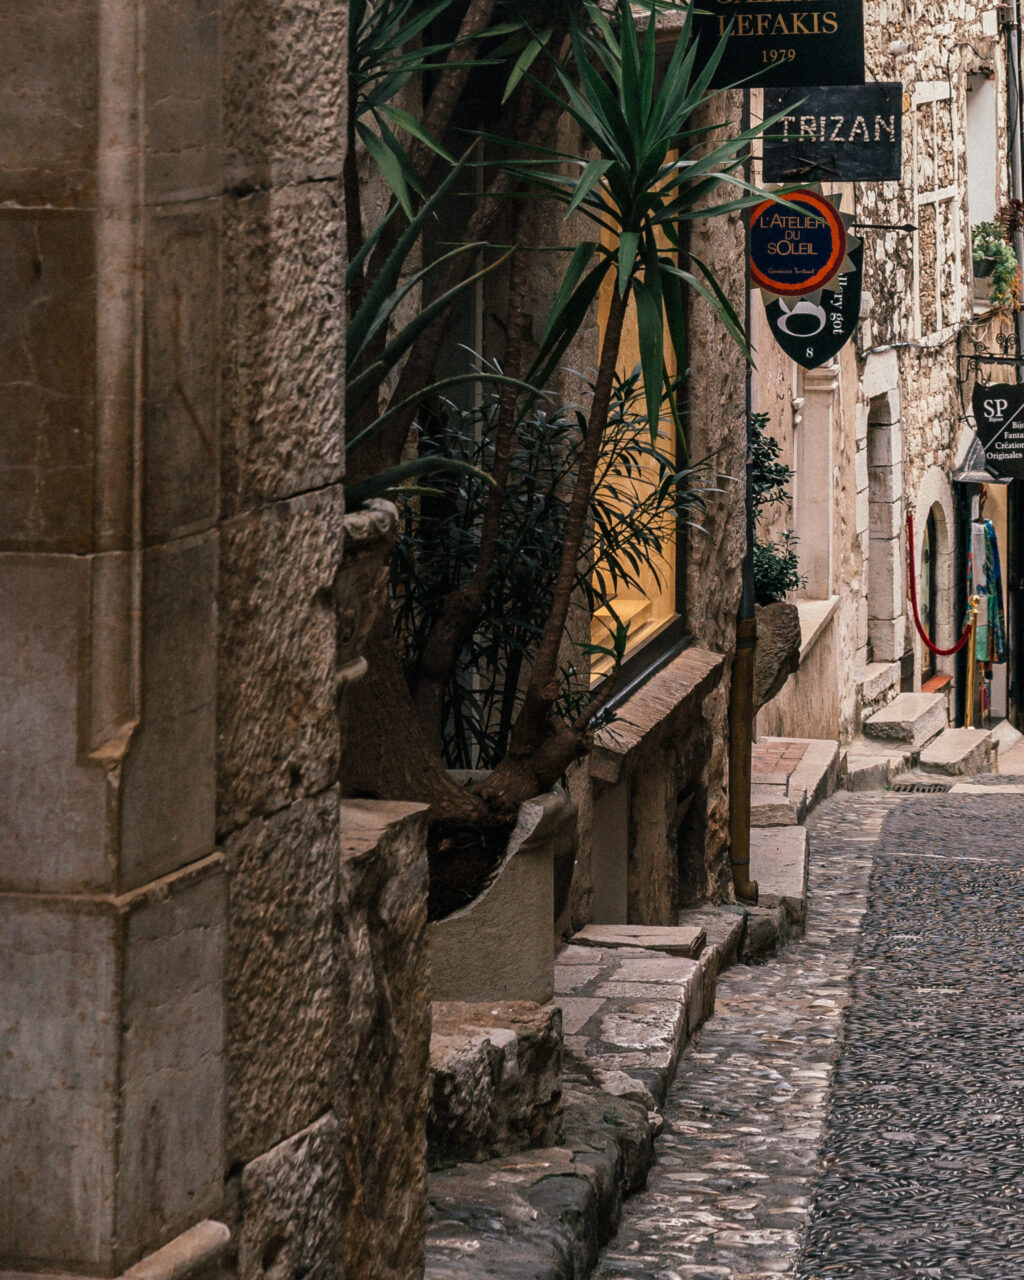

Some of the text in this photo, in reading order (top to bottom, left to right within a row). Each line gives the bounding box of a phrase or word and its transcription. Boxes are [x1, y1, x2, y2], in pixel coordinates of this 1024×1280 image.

[716, 11, 839, 37] LEFAKIS
[762, 48, 796, 63] 1979
[779, 114, 896, 142] TRIZAN
[760, 213, 826, 229] L'ATELIER
[785, 230, 801, 240] DU
[767, 239, 818, 255] SOLEIL
[805, 346, 814, 359] 8
[983, 398, 1009, 418] SP
[986, 451, 1023, 461] Originales
